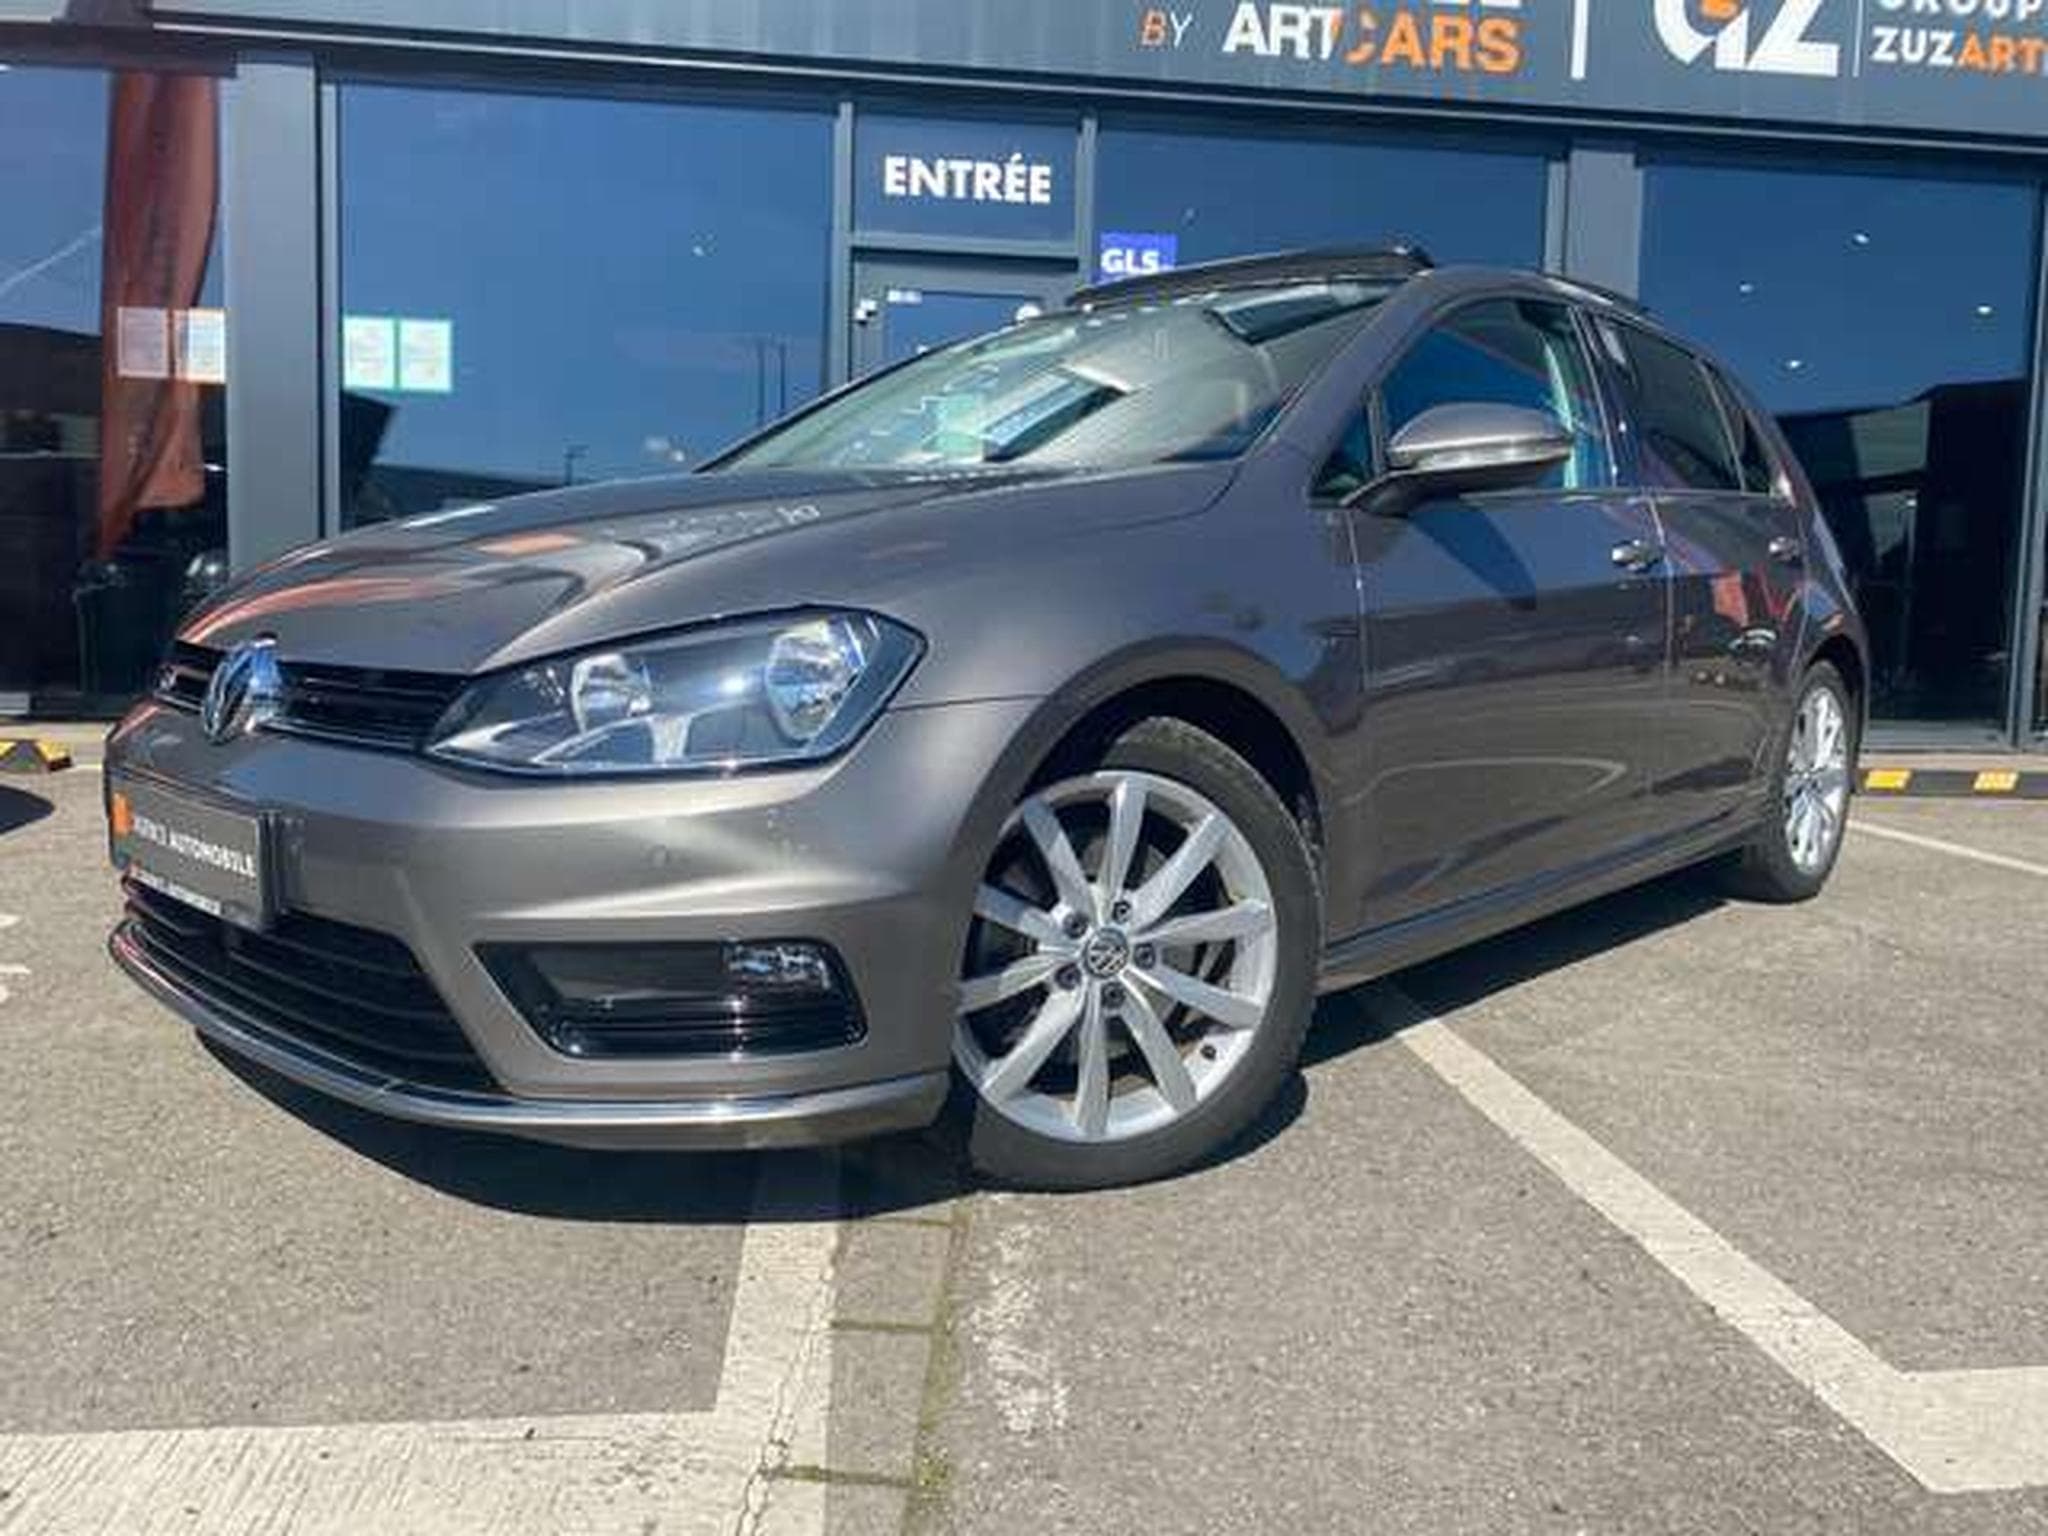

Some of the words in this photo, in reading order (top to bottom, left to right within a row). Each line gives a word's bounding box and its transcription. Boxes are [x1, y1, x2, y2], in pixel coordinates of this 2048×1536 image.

[1140, 11, 1192, 48] BY
[1871, 25, 2048, 76] ZUZART
[884, 153, 1051, 204] ENTRÉE
